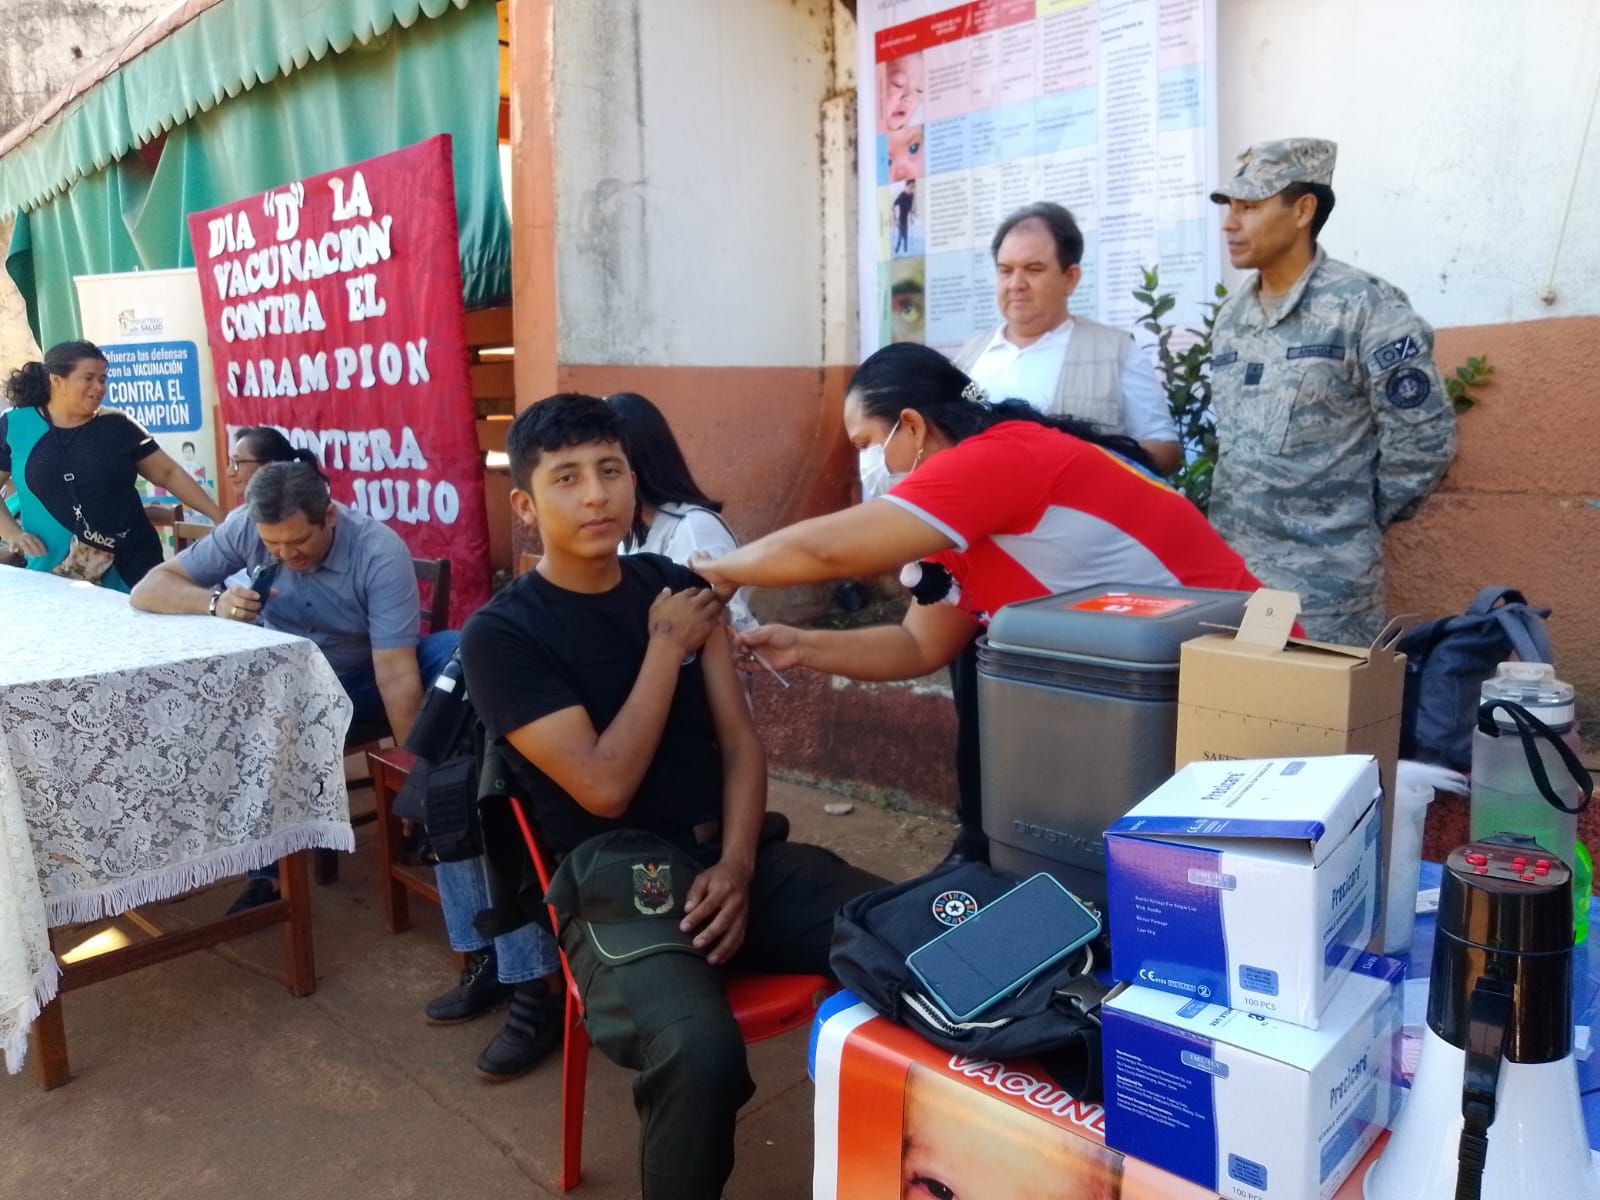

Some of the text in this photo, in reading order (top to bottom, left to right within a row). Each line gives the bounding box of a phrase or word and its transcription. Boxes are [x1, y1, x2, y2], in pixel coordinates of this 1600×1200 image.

[208, 211, 256, 258] DIA
[328, 171, 373, 221] LA
[213, 215, 392, 300] VACUNACION
[221, 274, 386, 343] CONTRA EL
[108, 361, 183, 378] con la VACUNACIÓN
[137, 350, 149, 360] tus
[151, 347, 188, 360] defensas
[227, 337, 430, 398] SARAMPION
[109, 379, 185, 404] CONTRA EL
[119, 401, 190, 426] RAMPIÓN
[226, 424, 428, 471] ONTERA
[351, 478, 460, 524] JULIO
[1245, 997, 1277, 1011] 100 PCS
[1329, 1053, 1368, 1111] Precicare
[1232, 1187, 1246, 1198] 100
